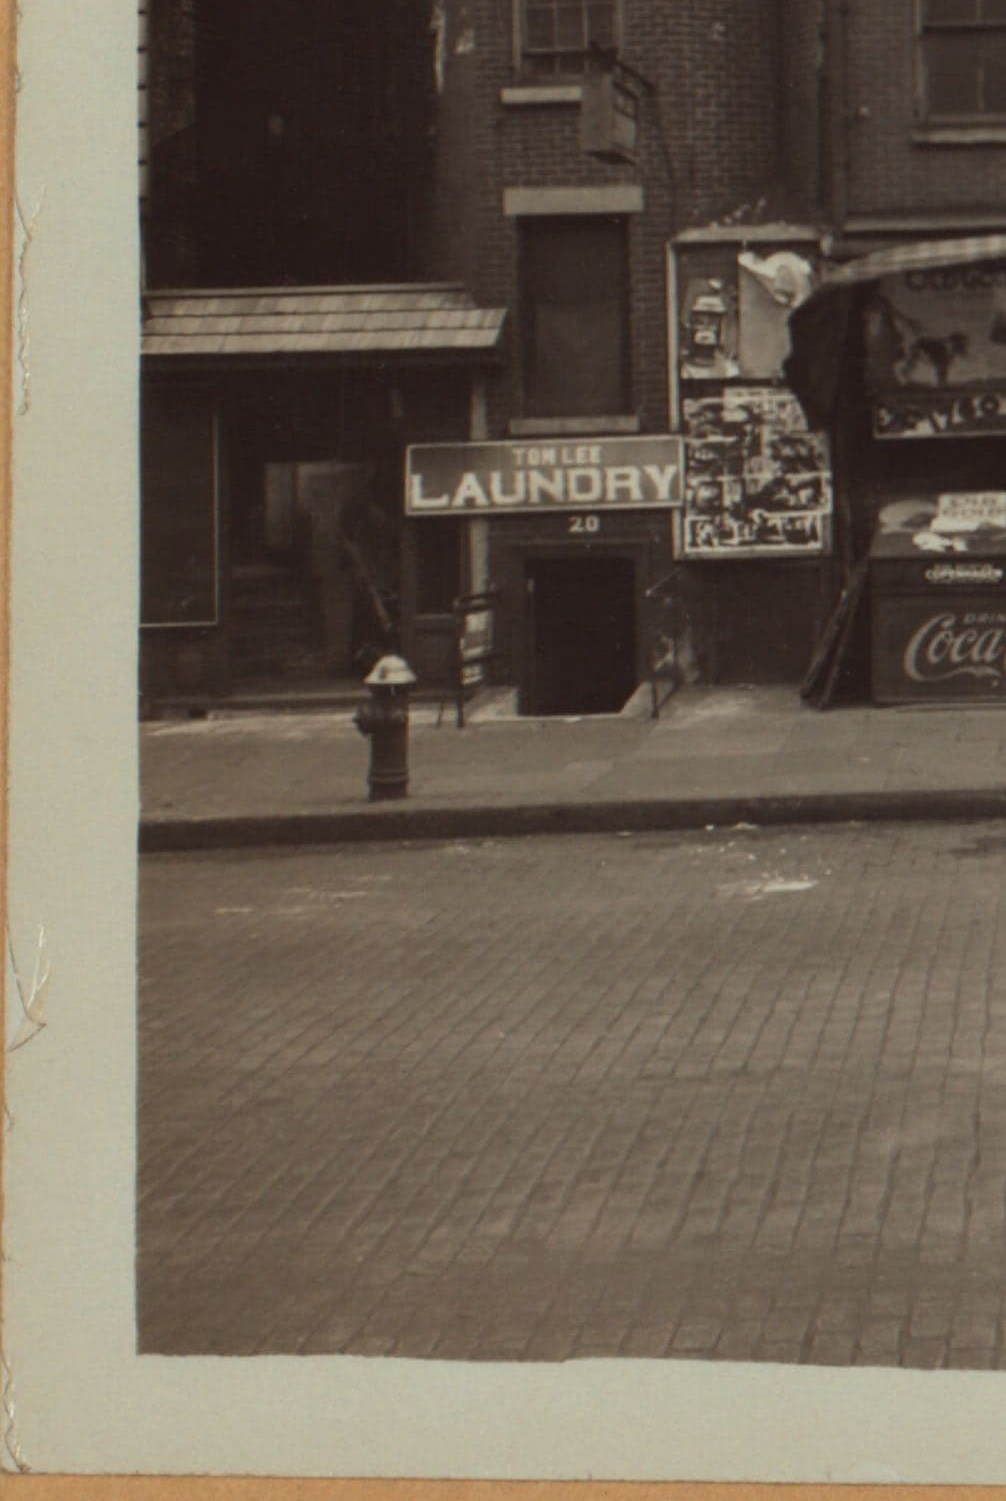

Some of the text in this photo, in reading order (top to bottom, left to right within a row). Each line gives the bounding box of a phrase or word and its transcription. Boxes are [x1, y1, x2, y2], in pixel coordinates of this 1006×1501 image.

[511, 444, 603, 467] TOM LEE
[410, 464, 678, 509] LAUNDRY
[568, 515, 601, 535] 20
